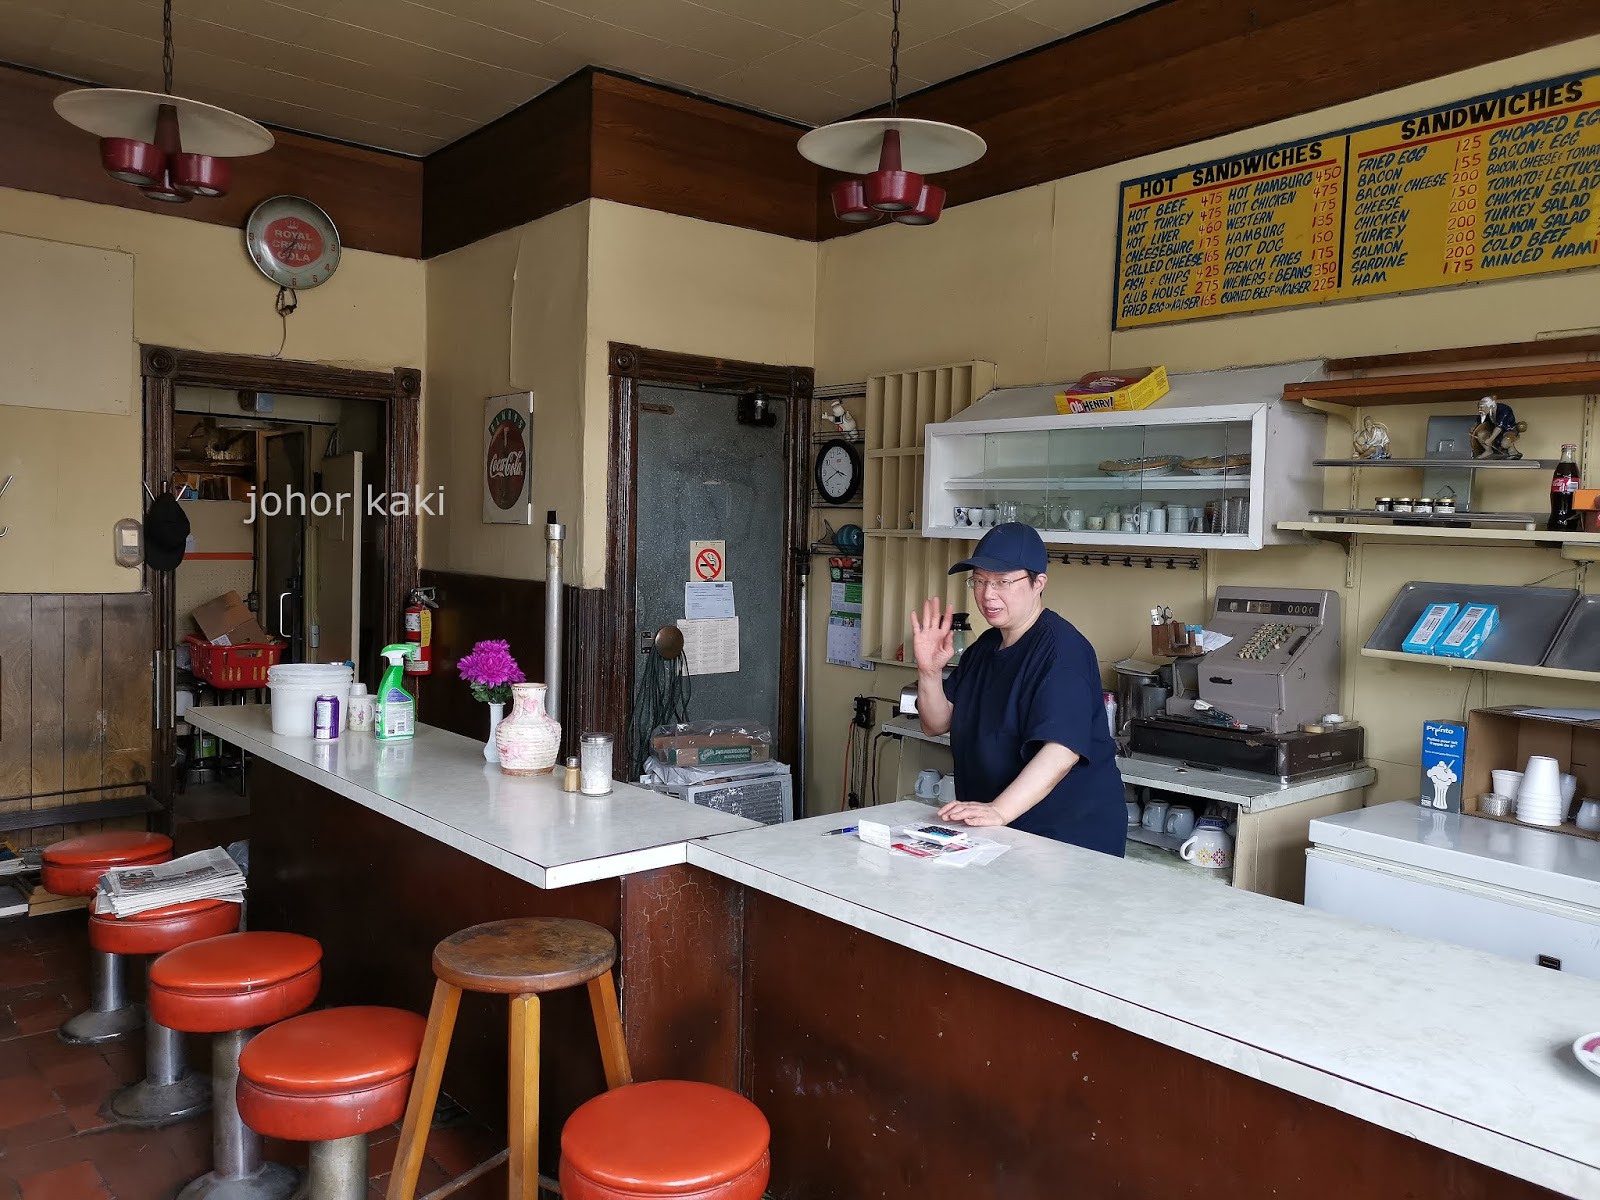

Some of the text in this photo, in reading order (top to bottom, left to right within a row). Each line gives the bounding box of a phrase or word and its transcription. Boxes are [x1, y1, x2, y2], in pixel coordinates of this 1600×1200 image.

[1402, 80, 1582, 140] SANDWICHES
[1489, 116, 1568, 146] CHOPPED
[1358, 135, 1482, 173] FRIED EGG 125
[1488, 139, 1540, 161] BACON
[1549, 131, 1580, 150] EGG
[1520, 152, 1559, 169] CHEESE
[1140, 142, 1322, 198] HOT SANDWICHES
[1228, 166, 1342, 201] HOT HAMBURG 450
[1358, 153, 1481, 188] BACON 155
[1488, 170, 1538, 191] TOMATO
[1227, 183, 1338, 215] HOT CHICKEN 475
[1355, 184, 1478, 215] CHEESE 150
[1356, 183, 1398, 201] BACON
[1404, 173, 1449, 192] CHEESE
[1452, 170, 1479, 184] 200
[1485, 184, 1544, 207] CHICKEN
[1128, 192, 1222, 222] HOT BEEF 475
[1128, 207, 1221, 236] HOT TURKEY 475
[1226, 199, 1336, 230] WESTERN 175
[1354, 199, 1477, 230] CHICKEN 200
[1485, 193, 1590, 222] TURKEY SALAD
[275, 230, 312, 240] ROYAL
[1126, 220, 1222, 249] HOT LIVER 460
[1225, 213, 1333, 245] HAMBURG 135
[1355, 214, 1476, 244] TURKEY 200
[1481, 209, 1590, 239] SALMON SALAD
[1126, 235, 1219, 263] CHEESEBURG 175
[1225, 230, 1333, 260] HOT DOG 150
[1351, 230, 1475, 259] SALMON 200
[1481, 248, 1544, 268] MINCED
[1552, 240, 1592, 259] HAM
[1482, 227, 1571, 253] COLD BEEF
[277, 252, 310, 262] COLA
[1165, 252, 1204, 271] CHEESE
[1204, 250, 1220, 263] 165
[1224, 246, 1334, 275] FRENCH FRIES 175
[1350, 244, 1475, 273] SARDINE 200
[1123, 278, 1146, 290] FISH
[1159, 270, 1191, 286] CHIPS
[1197, 265, 1220, 278] 425
[1223, 271, 1266, 289] WIENERS
[1274, 264, 1312, 283] BEANS
[1315, 262, 1336, 276] 350
[1352, 259, 1474, 286] HAM 175
[1123, 280, 1219, 304] CLUB HOUSE 275
[1221, 289, 1252, 304] CORNED
[1252, 286, 1275, 300] BEEF
[1280, 280, 1312, 295] KAISER
[1313, 277, 1335, 291] 225
[1122, 303, 1147, 318] FRIED
[1148, 302, 1164, 315] EGG
[1171, 296, 1200, 311] KAISER
[1200, 294, 1217, 306] 165
[1069, 401, 1082, 413] Oh
[1082, 397, 1114, 412] HENRY!
